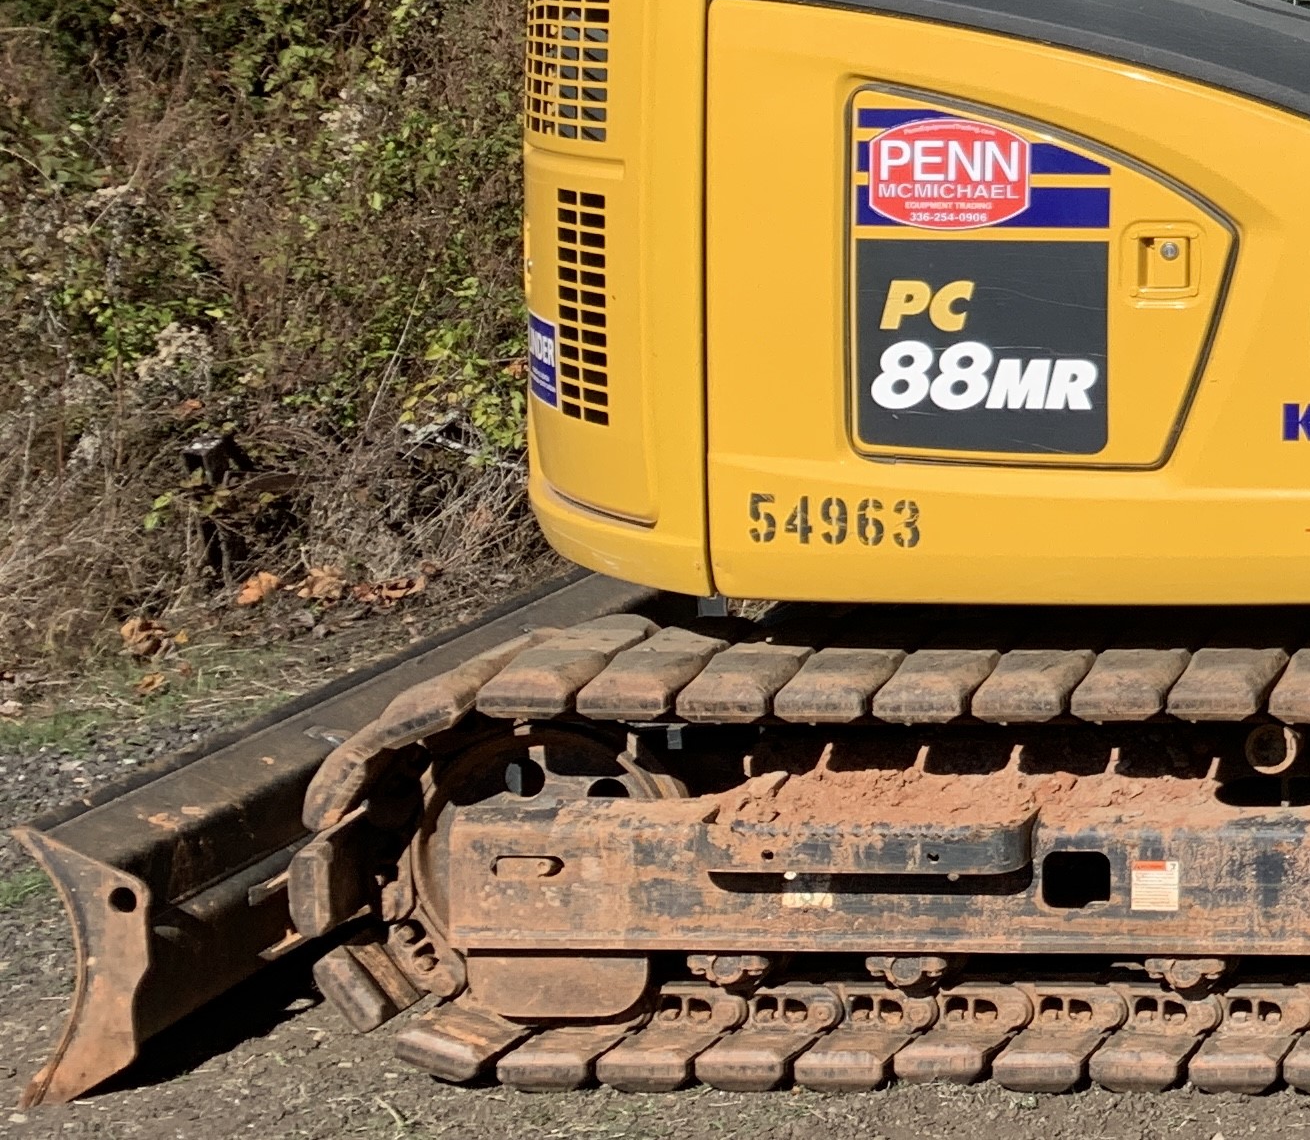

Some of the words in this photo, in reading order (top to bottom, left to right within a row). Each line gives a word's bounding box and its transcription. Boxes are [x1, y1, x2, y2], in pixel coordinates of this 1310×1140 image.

[879, 139, 1020, 183] PENN
[877, 183, 1020, 199] MCMICHAEL
[904, 201, 953, 210] EQUIPMENT
[954, 201, 993, 210] TRADING
[909, 211, 988, 223] 336-254-0906
[879, 280, 976, 332] PC
[870, 340, 1099, 412] 88MR
[749, 492, 922, 548] 54963
